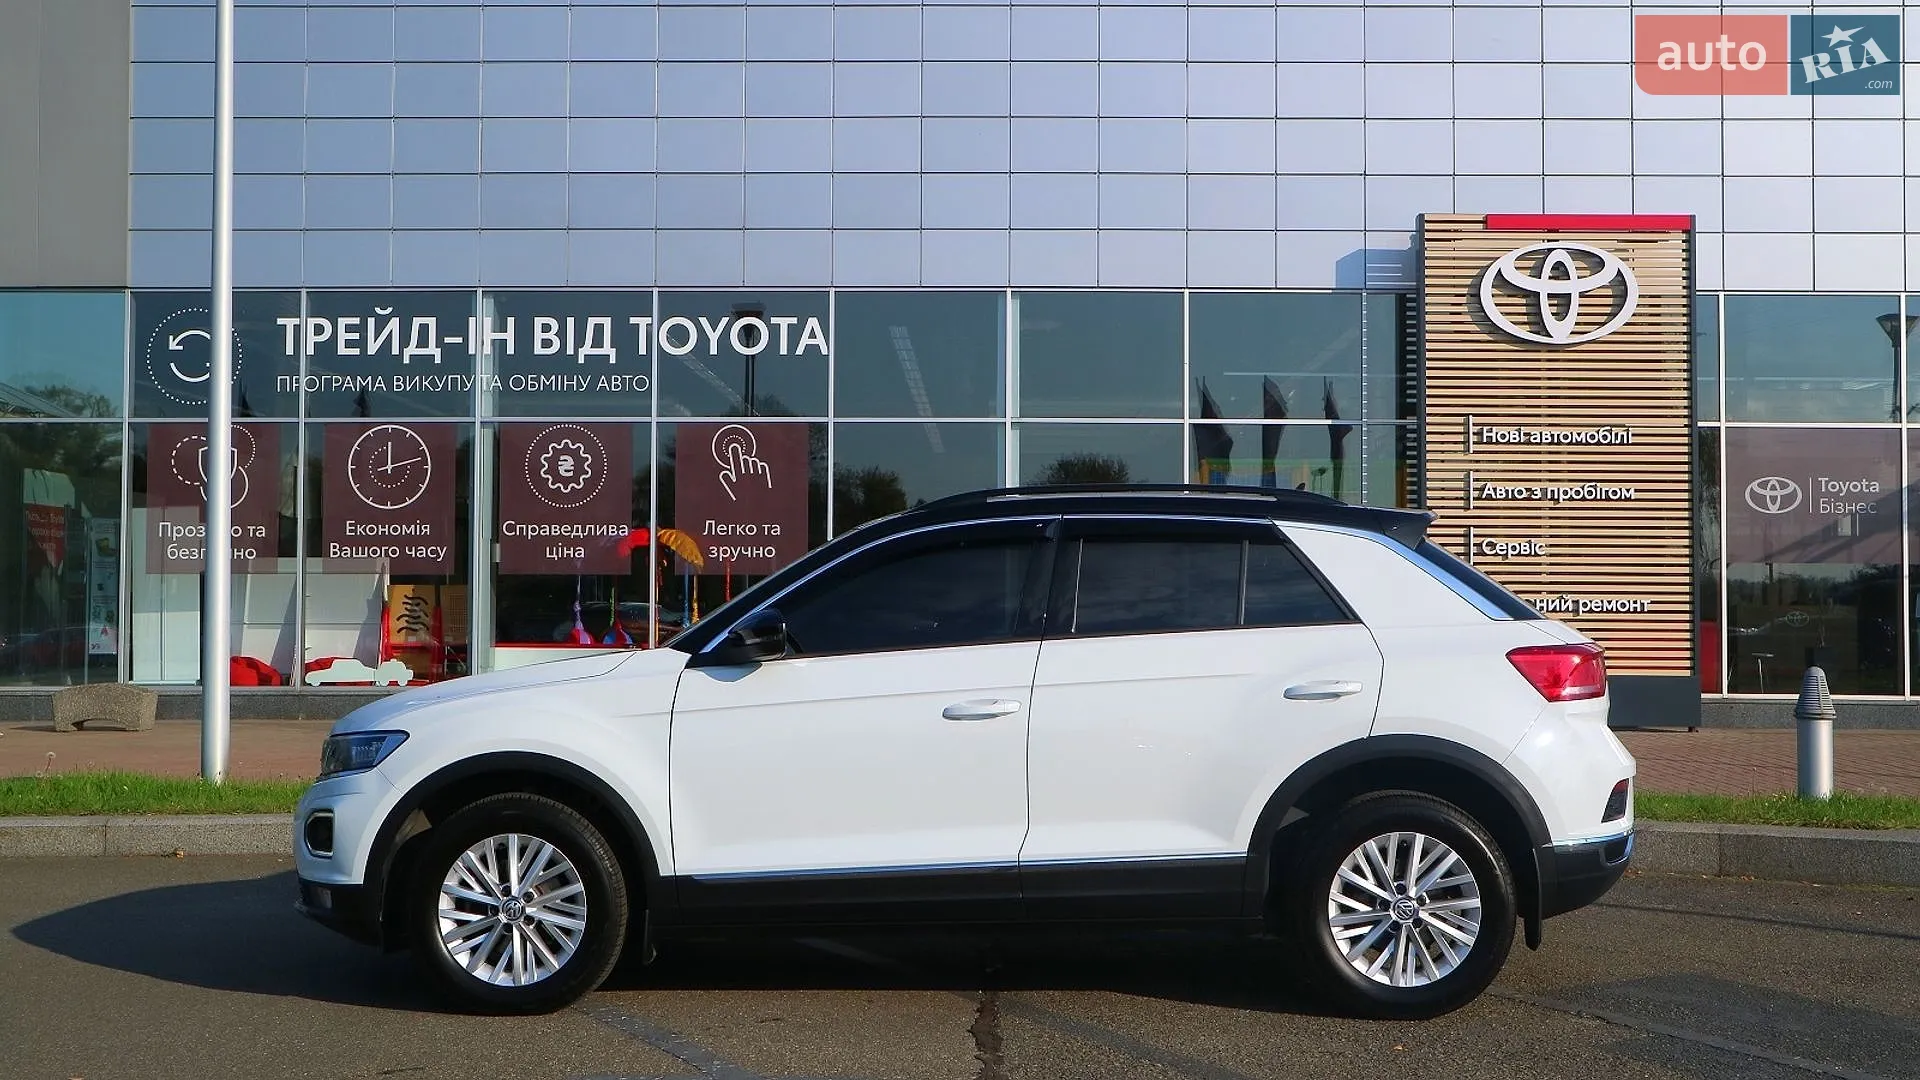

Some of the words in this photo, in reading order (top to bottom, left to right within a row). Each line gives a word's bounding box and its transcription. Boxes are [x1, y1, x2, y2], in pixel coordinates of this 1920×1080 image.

[276, 306, 516, 364] ТРЕЙД-ІН
[533, 317, 616, 364] ВІД
[276, 374, 387, 393] ПРОГРАМА
[393, 374, 476, 393] ВИКУПУ
[509, 373, 592, 393] ОБМІНУ
[597, 373, 650, 393] АВТО
[1482, 427, 1525, 443] Нові
[1530, 427, 1632, 444] автомобілі
[1482, 483, 1526, 499] Авто
[1532, 487, 1541, 499] з
[1547, 483, 1635, 503] пробігом
[1818, 477, 1879, 496] Toyota
[1820, 498, 1877, 514] Бізнес
[159, 522, 243, 543] Прозо
[247, 525, 267, 538] та
[345, 521, 431, 538] Економія
[502, 521, 629, 540] Справедлива
[702, 521, 758, 537] Легко
[762, 525, 781, 537] та
[329, 543, 400, 559] Вашого
[405, 546, 447, 563] часу
[545, 542, 585, 560] ціна
[708, 546, 776, 562] зручно
[1482, 540, 1546, 556] Сервіс
[1579, 600, 1651, 613] ремонт
